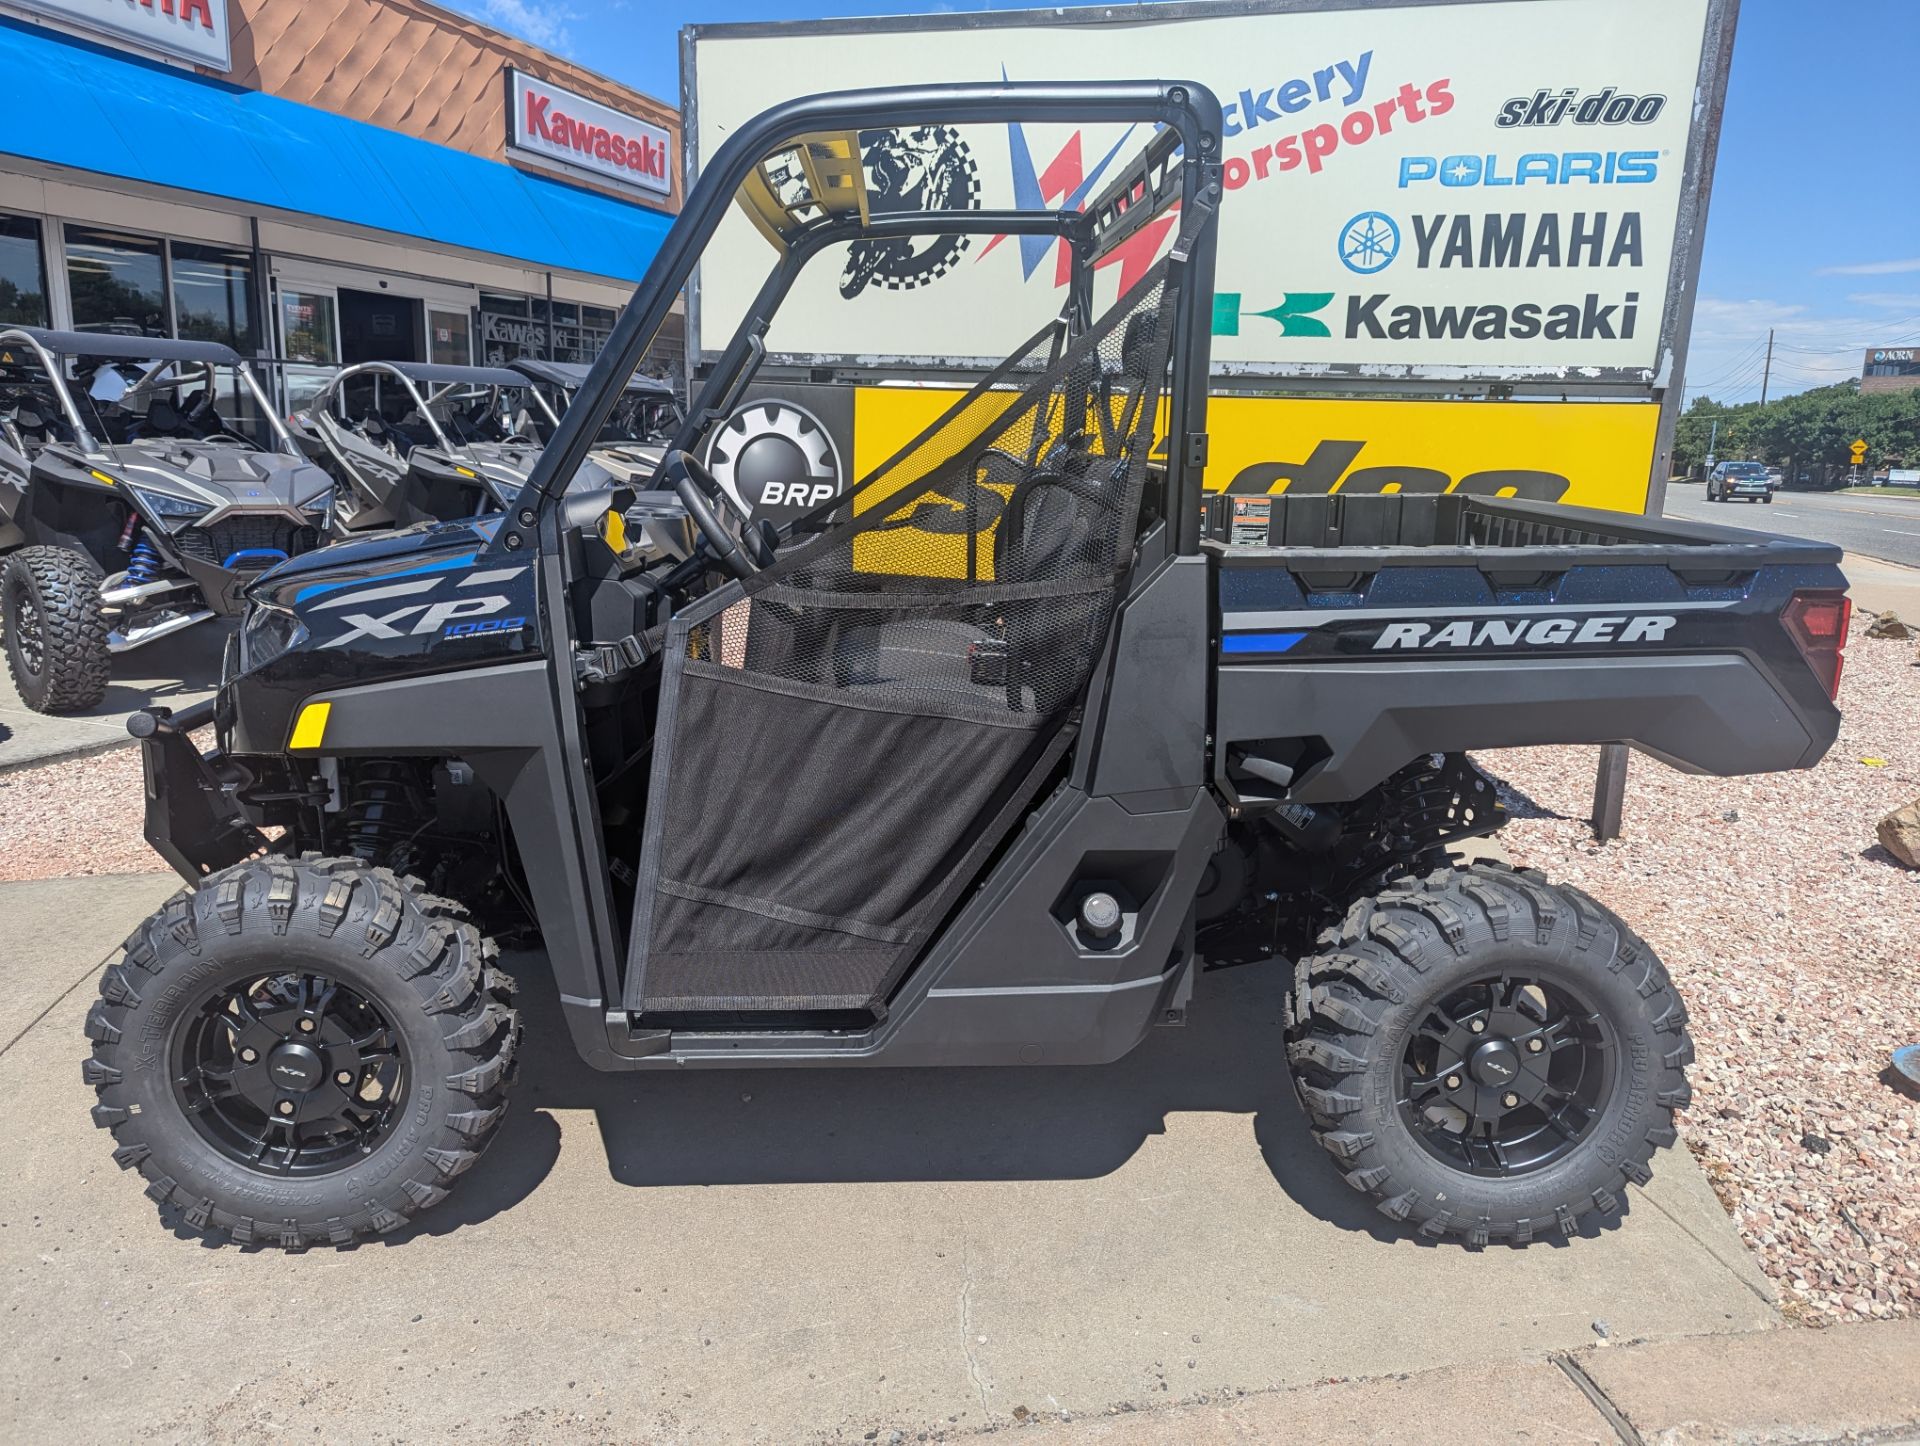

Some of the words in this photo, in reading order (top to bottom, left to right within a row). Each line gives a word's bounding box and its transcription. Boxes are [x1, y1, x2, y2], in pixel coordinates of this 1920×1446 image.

[1222, 50, 1374, 138] ckery
[1495, 87, 1667, 128] ski-doo
[526, 90, 666, 180] Kawasaki
[1222, 78, 1455, 191] orsports
[1398, 151, 1660, 189] POLARIS
[1411, 212, 1644, 269] YAMAHA
[483, 312, 568, 349] Kawaski
[1345, 292, 1640, 341] Kawasaki
[760, 481, 834, 508] BRP
[315, 595, 511, 650] XP
[445, 616, 527, 636] 1000
[1372, 616, 1677, 649] RANGER
